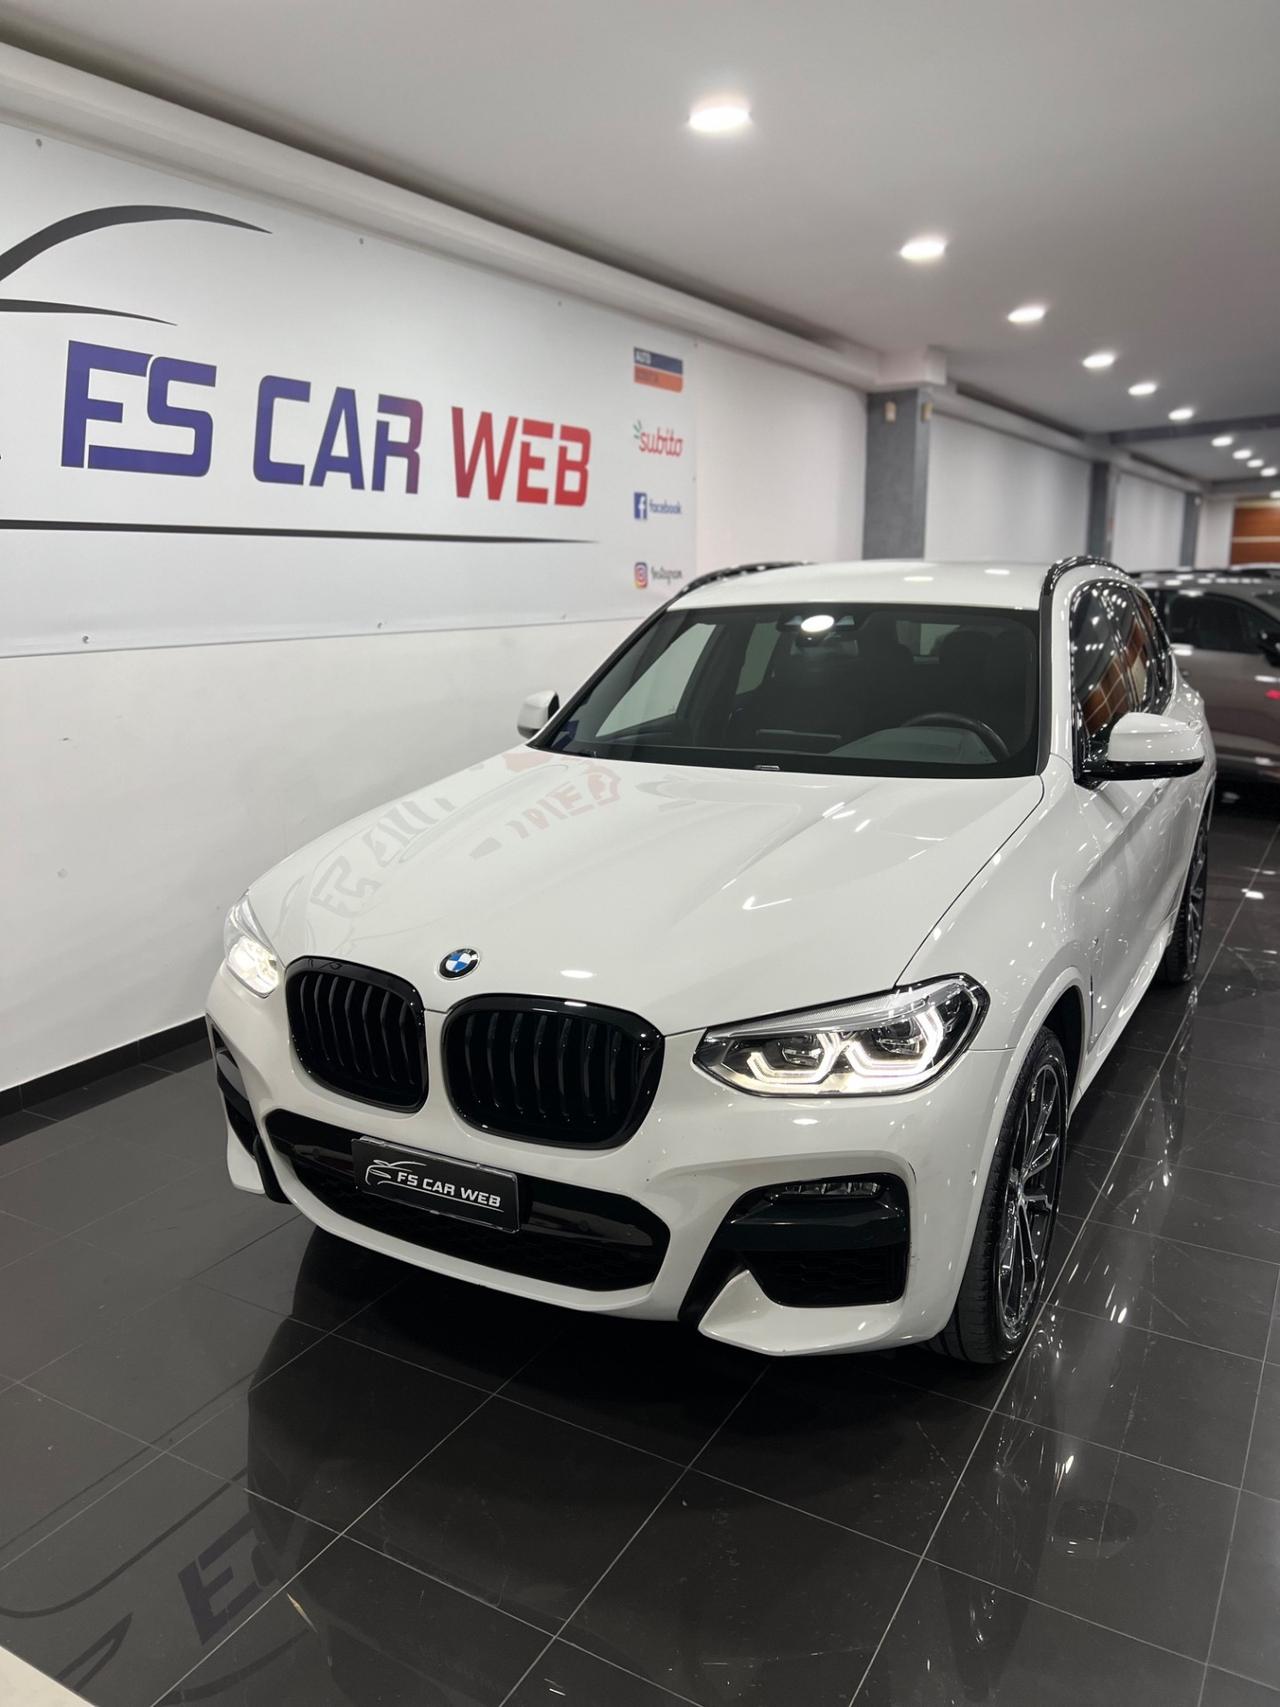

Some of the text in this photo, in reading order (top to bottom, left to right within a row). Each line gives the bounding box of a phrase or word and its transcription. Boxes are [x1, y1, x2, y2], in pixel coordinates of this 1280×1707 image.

[61, 339, 592, 507] FS CAR WEB
[639, 427, 684, 456] subito
[397, 1171, 501, 1207] FS CAR WEB
